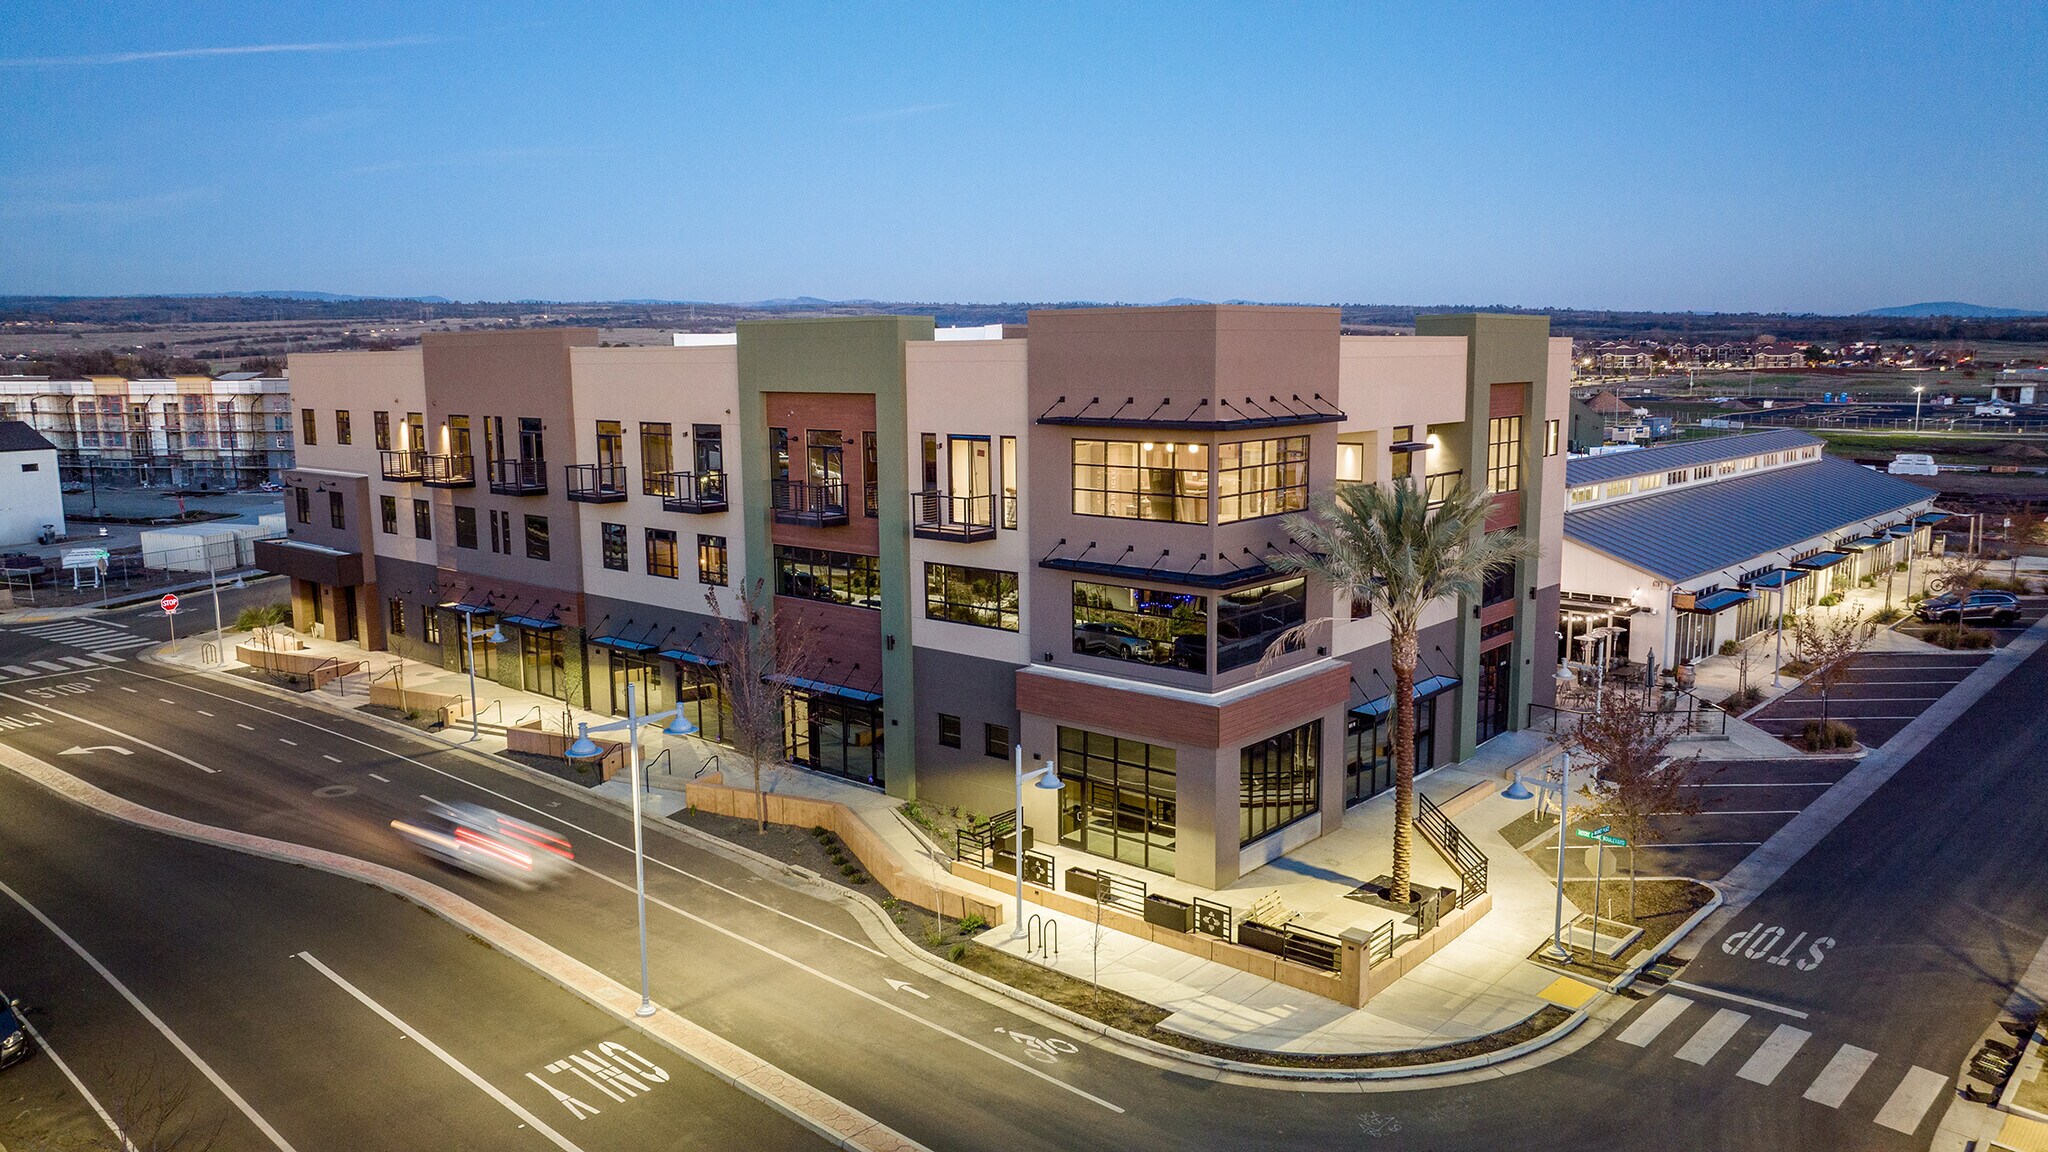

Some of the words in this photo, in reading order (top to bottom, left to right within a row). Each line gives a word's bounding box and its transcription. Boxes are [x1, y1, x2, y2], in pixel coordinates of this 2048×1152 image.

[162, 598, 178, 607] STOP
[25, 682, 95, 698] STOP
[1721, 922, 1836, 971] STOP
[525, 1041, 670, 1120] ONLY
